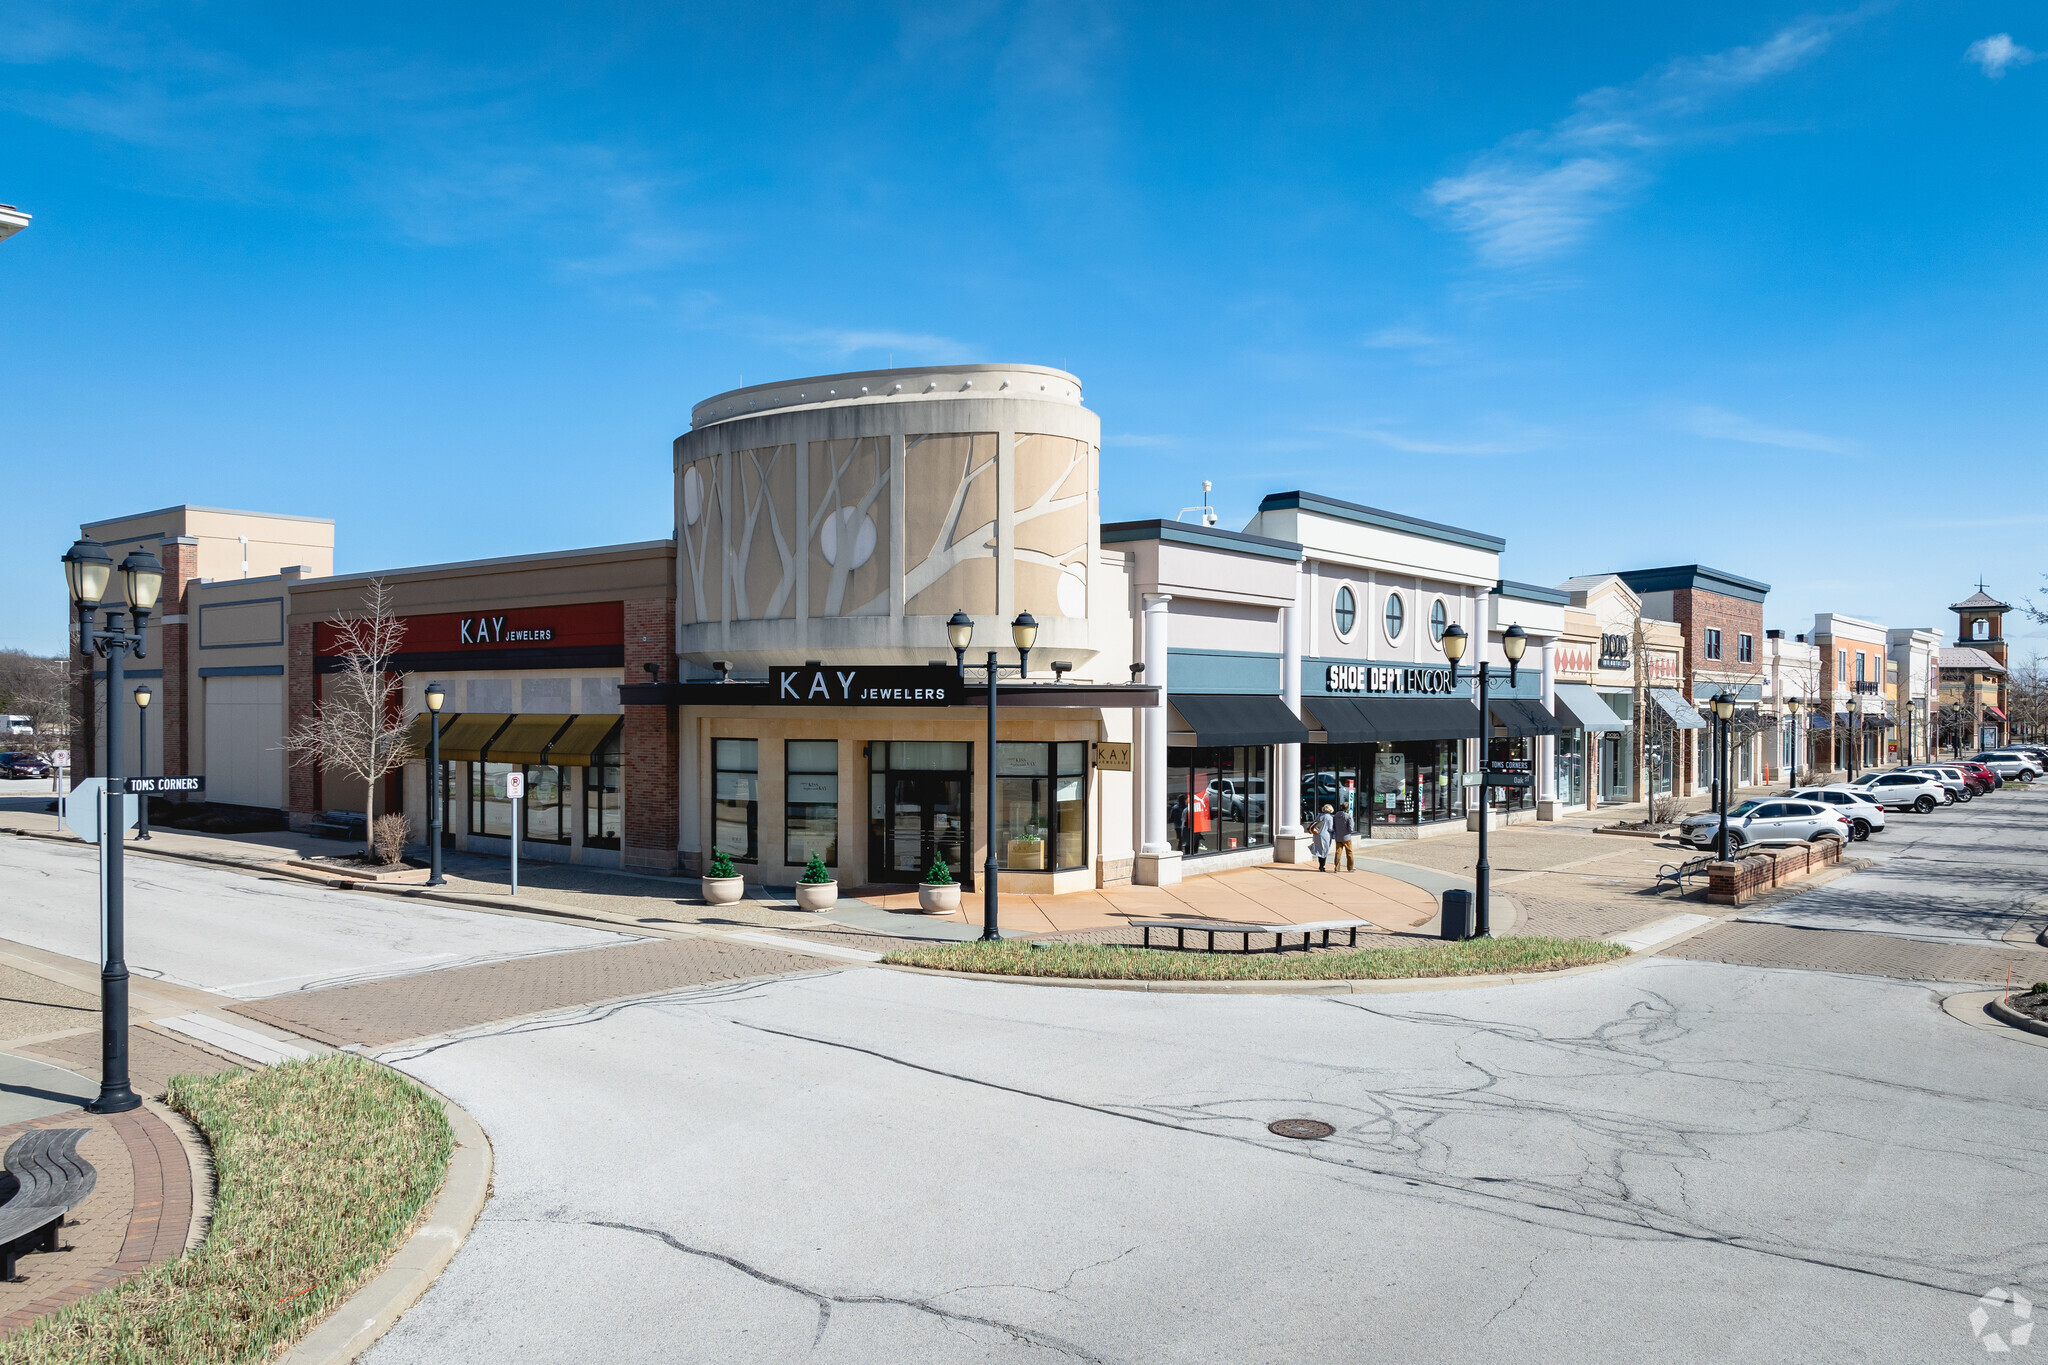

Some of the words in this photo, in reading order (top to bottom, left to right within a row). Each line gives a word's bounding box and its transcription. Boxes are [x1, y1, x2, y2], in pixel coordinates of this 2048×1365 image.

[461, 616, 504, 644] KAY
[505, 629, 551, 642] JEWELERS
[1601, 633, 1628, 657] DOJO
[780, 671, 856, 700] KAY
[860, 688, 945, 700] JEWELERS
[1330, 665, 1366, 690] SHOE
[1371, 667, 1404, 691] DEPT.
[1098, 749, 1129, 760] KAY
[1389, 755, 1401, 765] 19
[1505, 761, 1528, 769] CORNERS
[131, 780, 155, 791] TOMS
[158, 778, 199, 790] CORNERS
